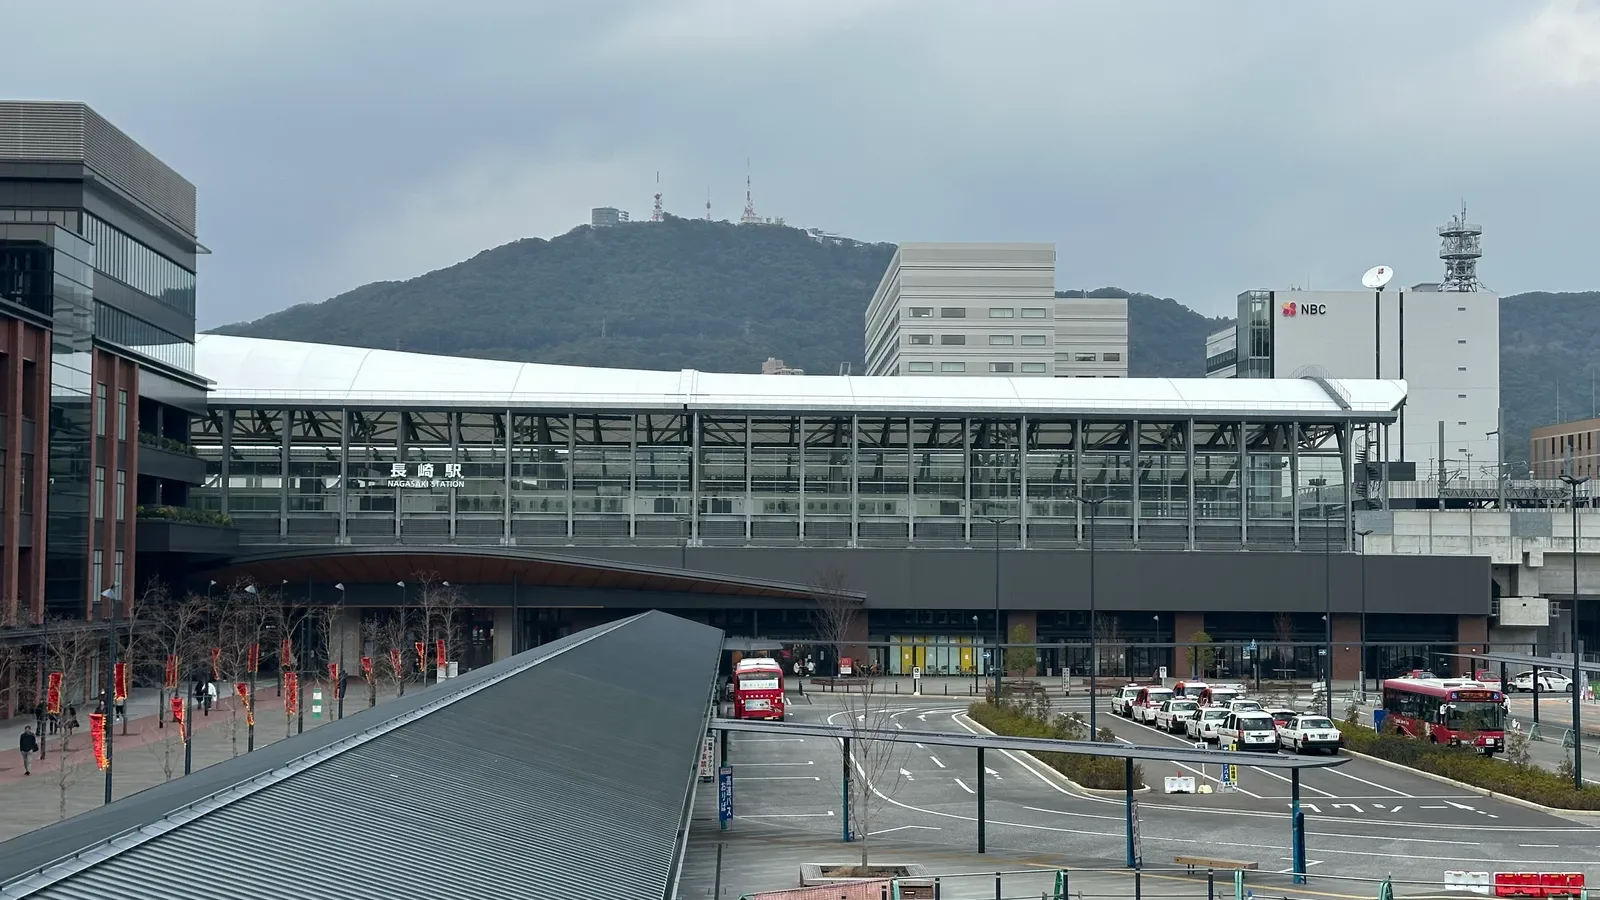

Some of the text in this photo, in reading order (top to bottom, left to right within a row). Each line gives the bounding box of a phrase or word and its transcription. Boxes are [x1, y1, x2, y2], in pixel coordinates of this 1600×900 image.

[1301, 304, 1326, 315] NBC
[390, 463, 462, 478] 長崎駅
[387, 480, 465, 488] NAGASAKI STATION
